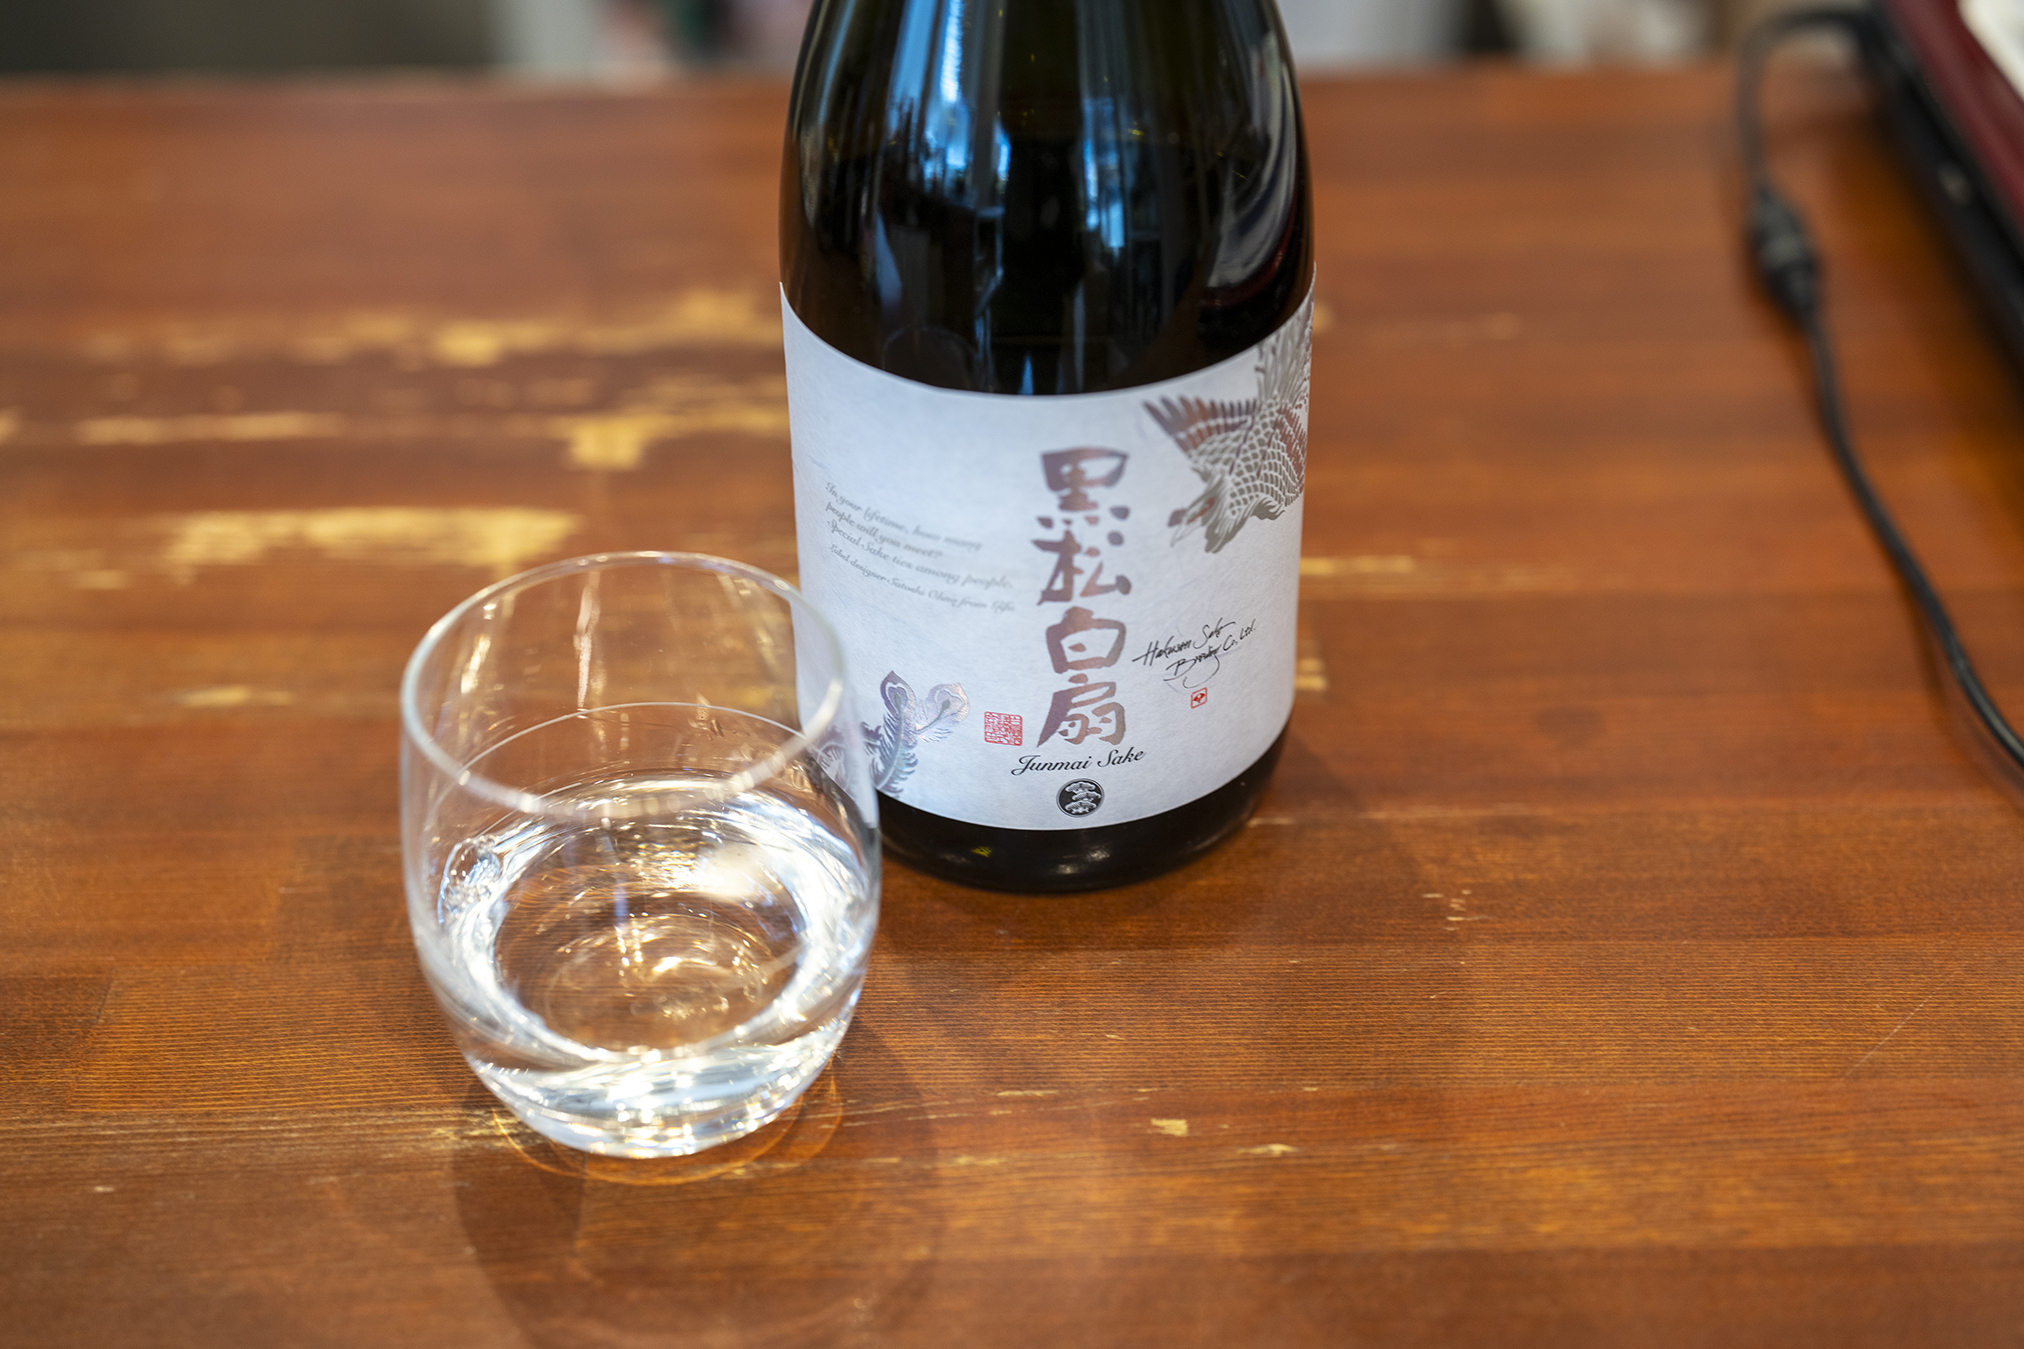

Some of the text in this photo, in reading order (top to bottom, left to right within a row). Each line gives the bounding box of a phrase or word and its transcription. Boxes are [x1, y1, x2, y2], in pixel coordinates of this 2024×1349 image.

[825, 482, 838, 498] In
[836, 496, 862, 511] your
[825, 501, 855, 526] people
[856, 523, 879, 538] will
[875, 535, 901, 547] you
[827, 519, 861, 546] Special
[861, 541, 890, 561] Sake
[915, 565, 961, 586] among
[829, 543, 850, 562] Label
[850, 559, 887, 582] designer
[1011, 746, 1146, 776] Junmai Sake
